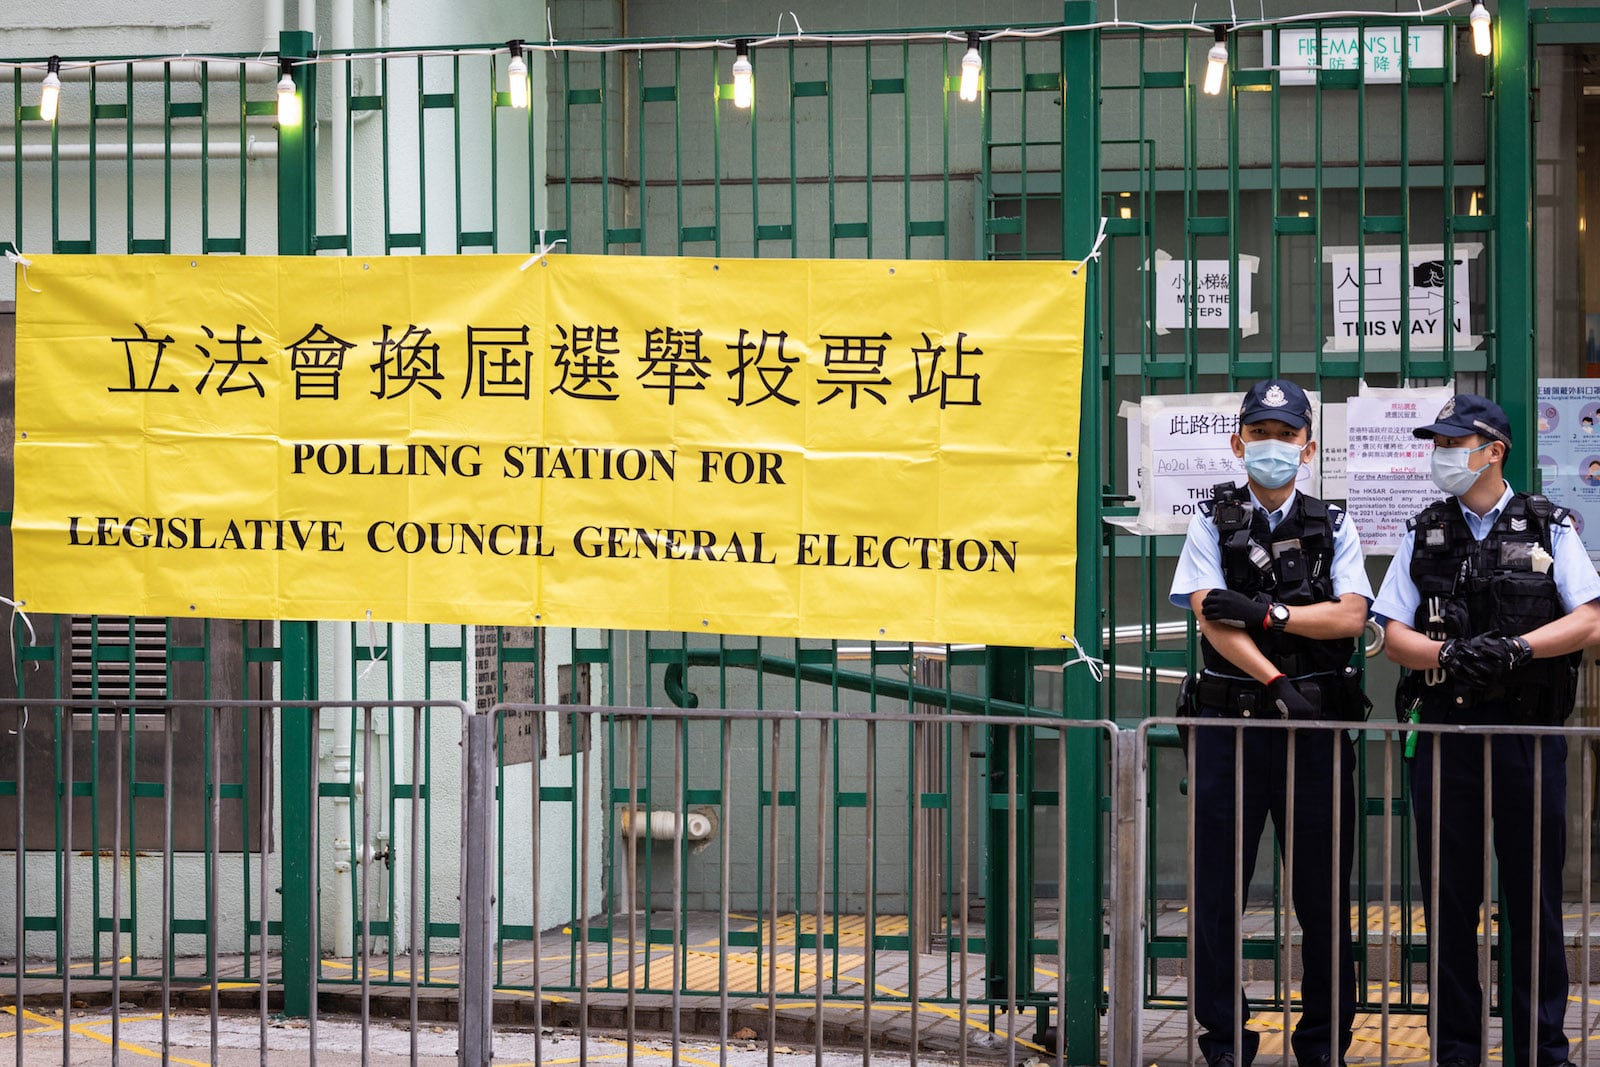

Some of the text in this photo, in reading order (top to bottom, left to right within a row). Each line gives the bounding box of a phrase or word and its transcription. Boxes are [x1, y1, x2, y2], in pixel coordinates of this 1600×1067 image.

[1393, 35, 1421, 54] LFT
[1337, 266, 1382, 289] 入口
[1176, 294, 1230, 304] MD THE
[1188, 307, 1222, 317] SEPS
[1342, 320, 1386, 337] THIS
[107, 322, 984, 410] 立法會換屆選舉投票站
[293, 443, 786, 485] POLLING STATION FOR
[1187, 488, 1215, 499] THIS
[69, 516, 1017, 573] LEGISLATIVE COUNCIL GENERAL ELECTION
